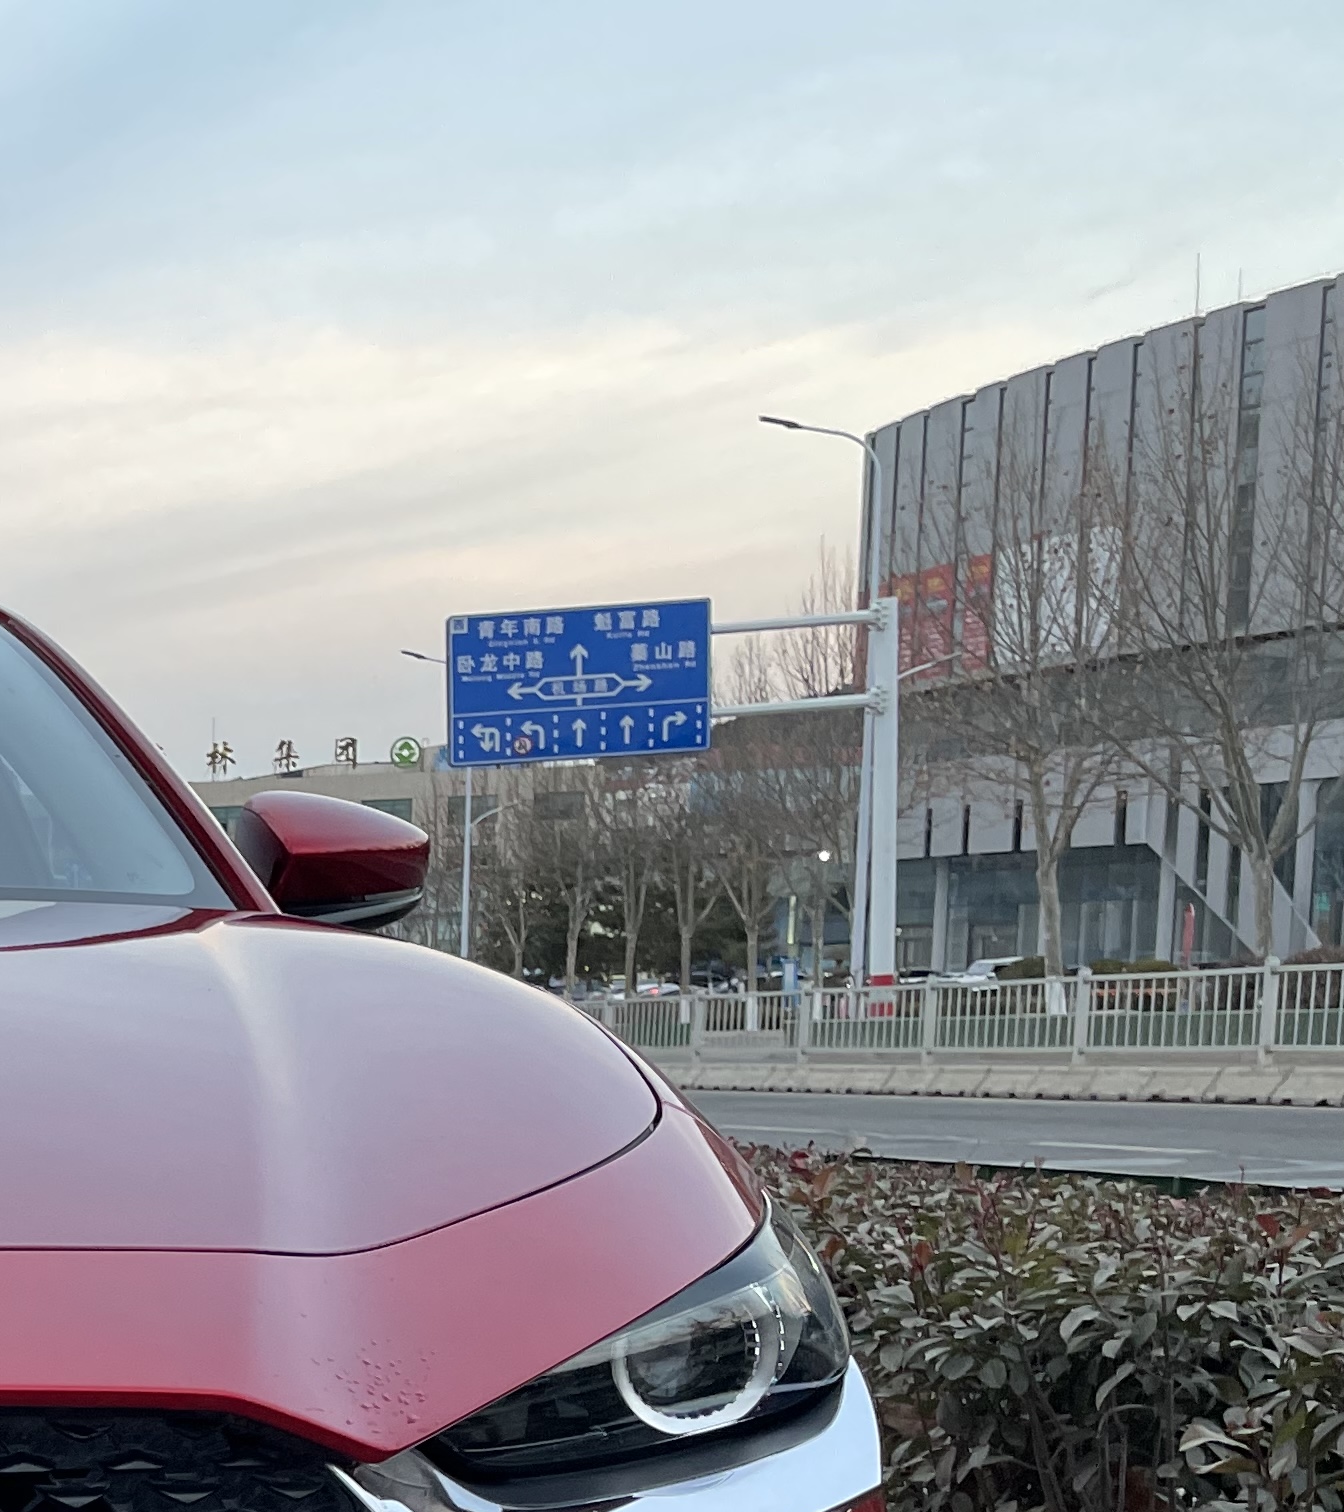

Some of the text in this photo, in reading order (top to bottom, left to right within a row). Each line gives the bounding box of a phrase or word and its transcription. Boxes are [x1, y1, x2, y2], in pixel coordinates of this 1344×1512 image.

[478, 616, 564, 640] 青年南路
[457, 650, 544, 674] 卧龙中路
